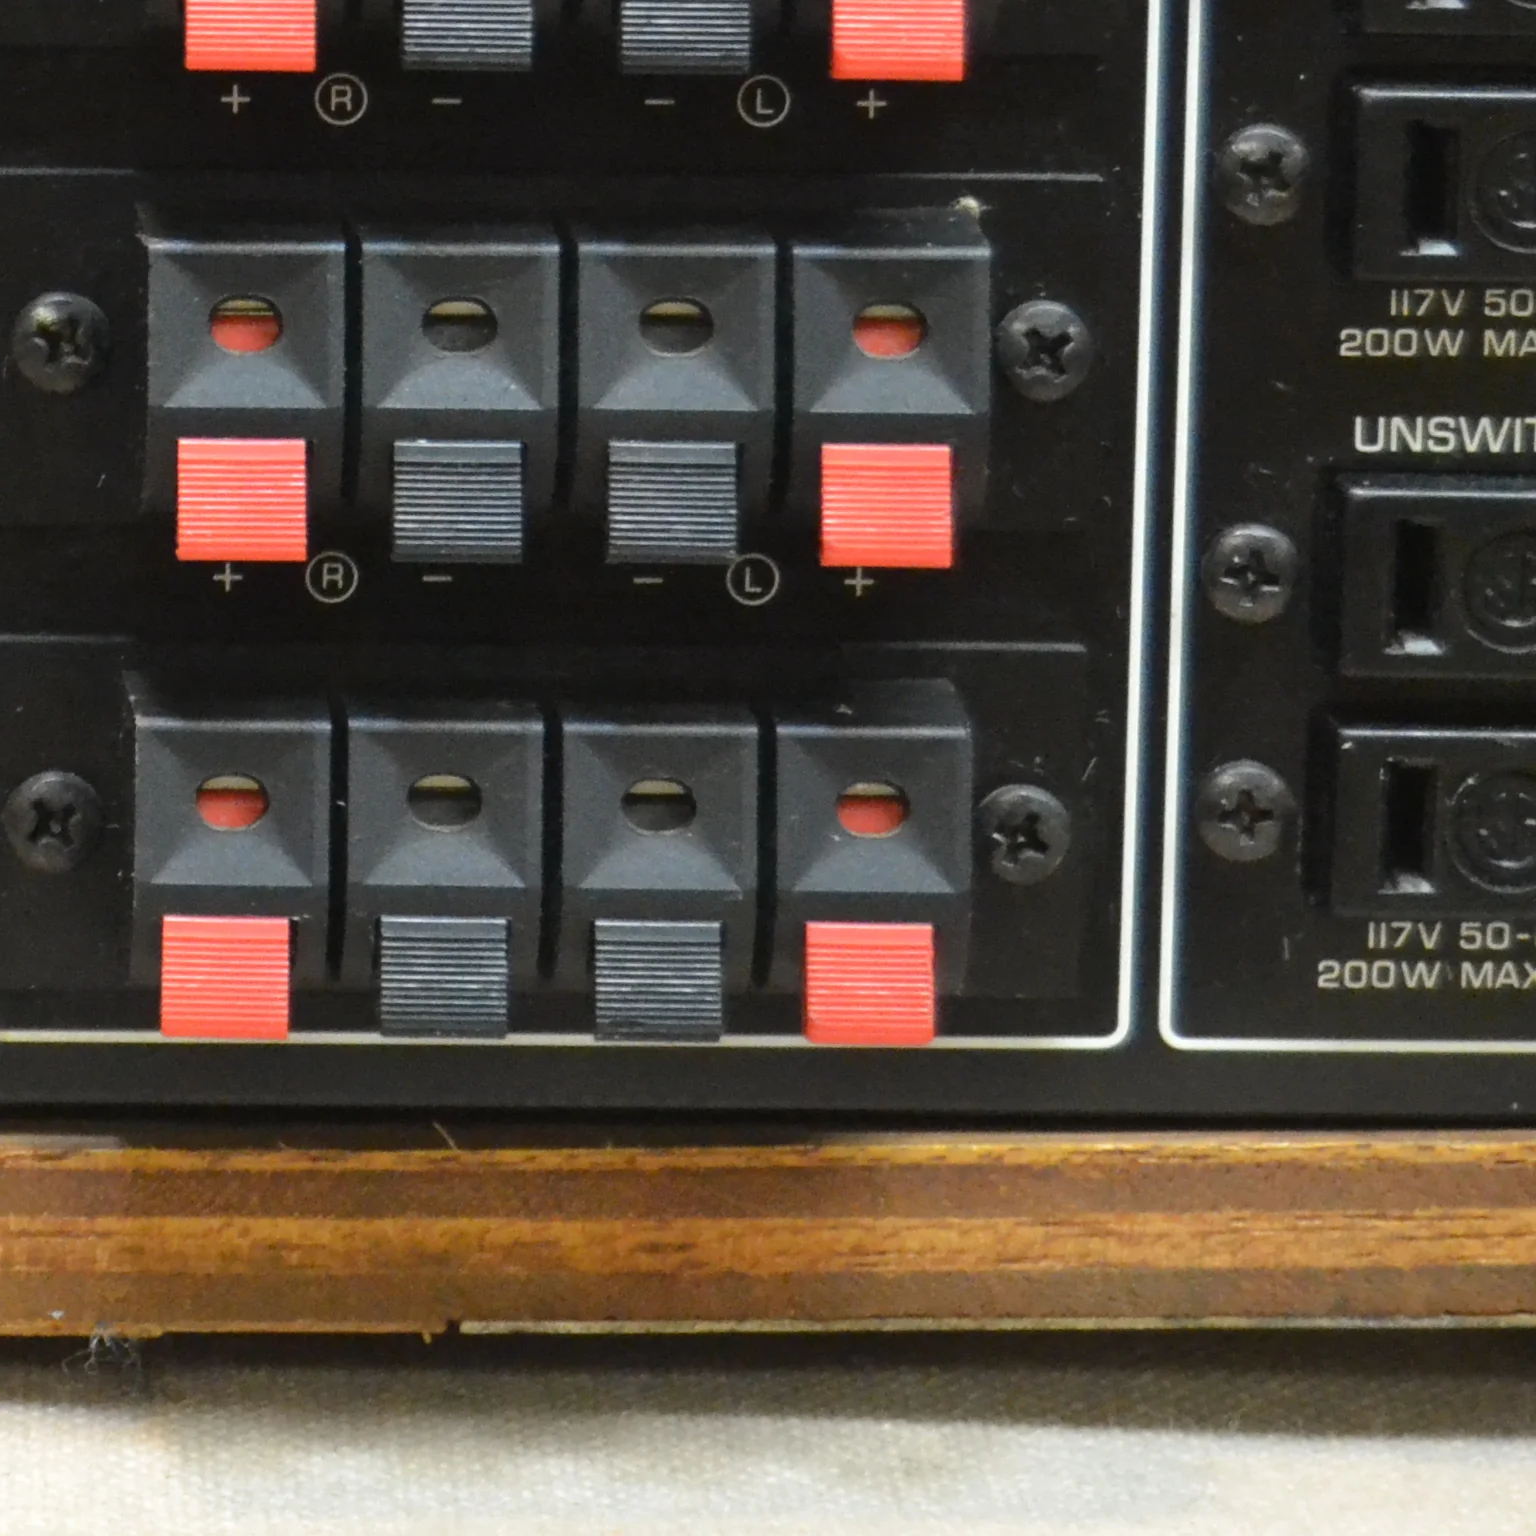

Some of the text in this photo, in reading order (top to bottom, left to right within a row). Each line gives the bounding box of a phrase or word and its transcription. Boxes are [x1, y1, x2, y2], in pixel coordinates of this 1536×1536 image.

[1340, 328, 1466, 358] 200W
[1460, 922, 1531, 952] 50-
[1318, 960, 1442, 990] 200W
